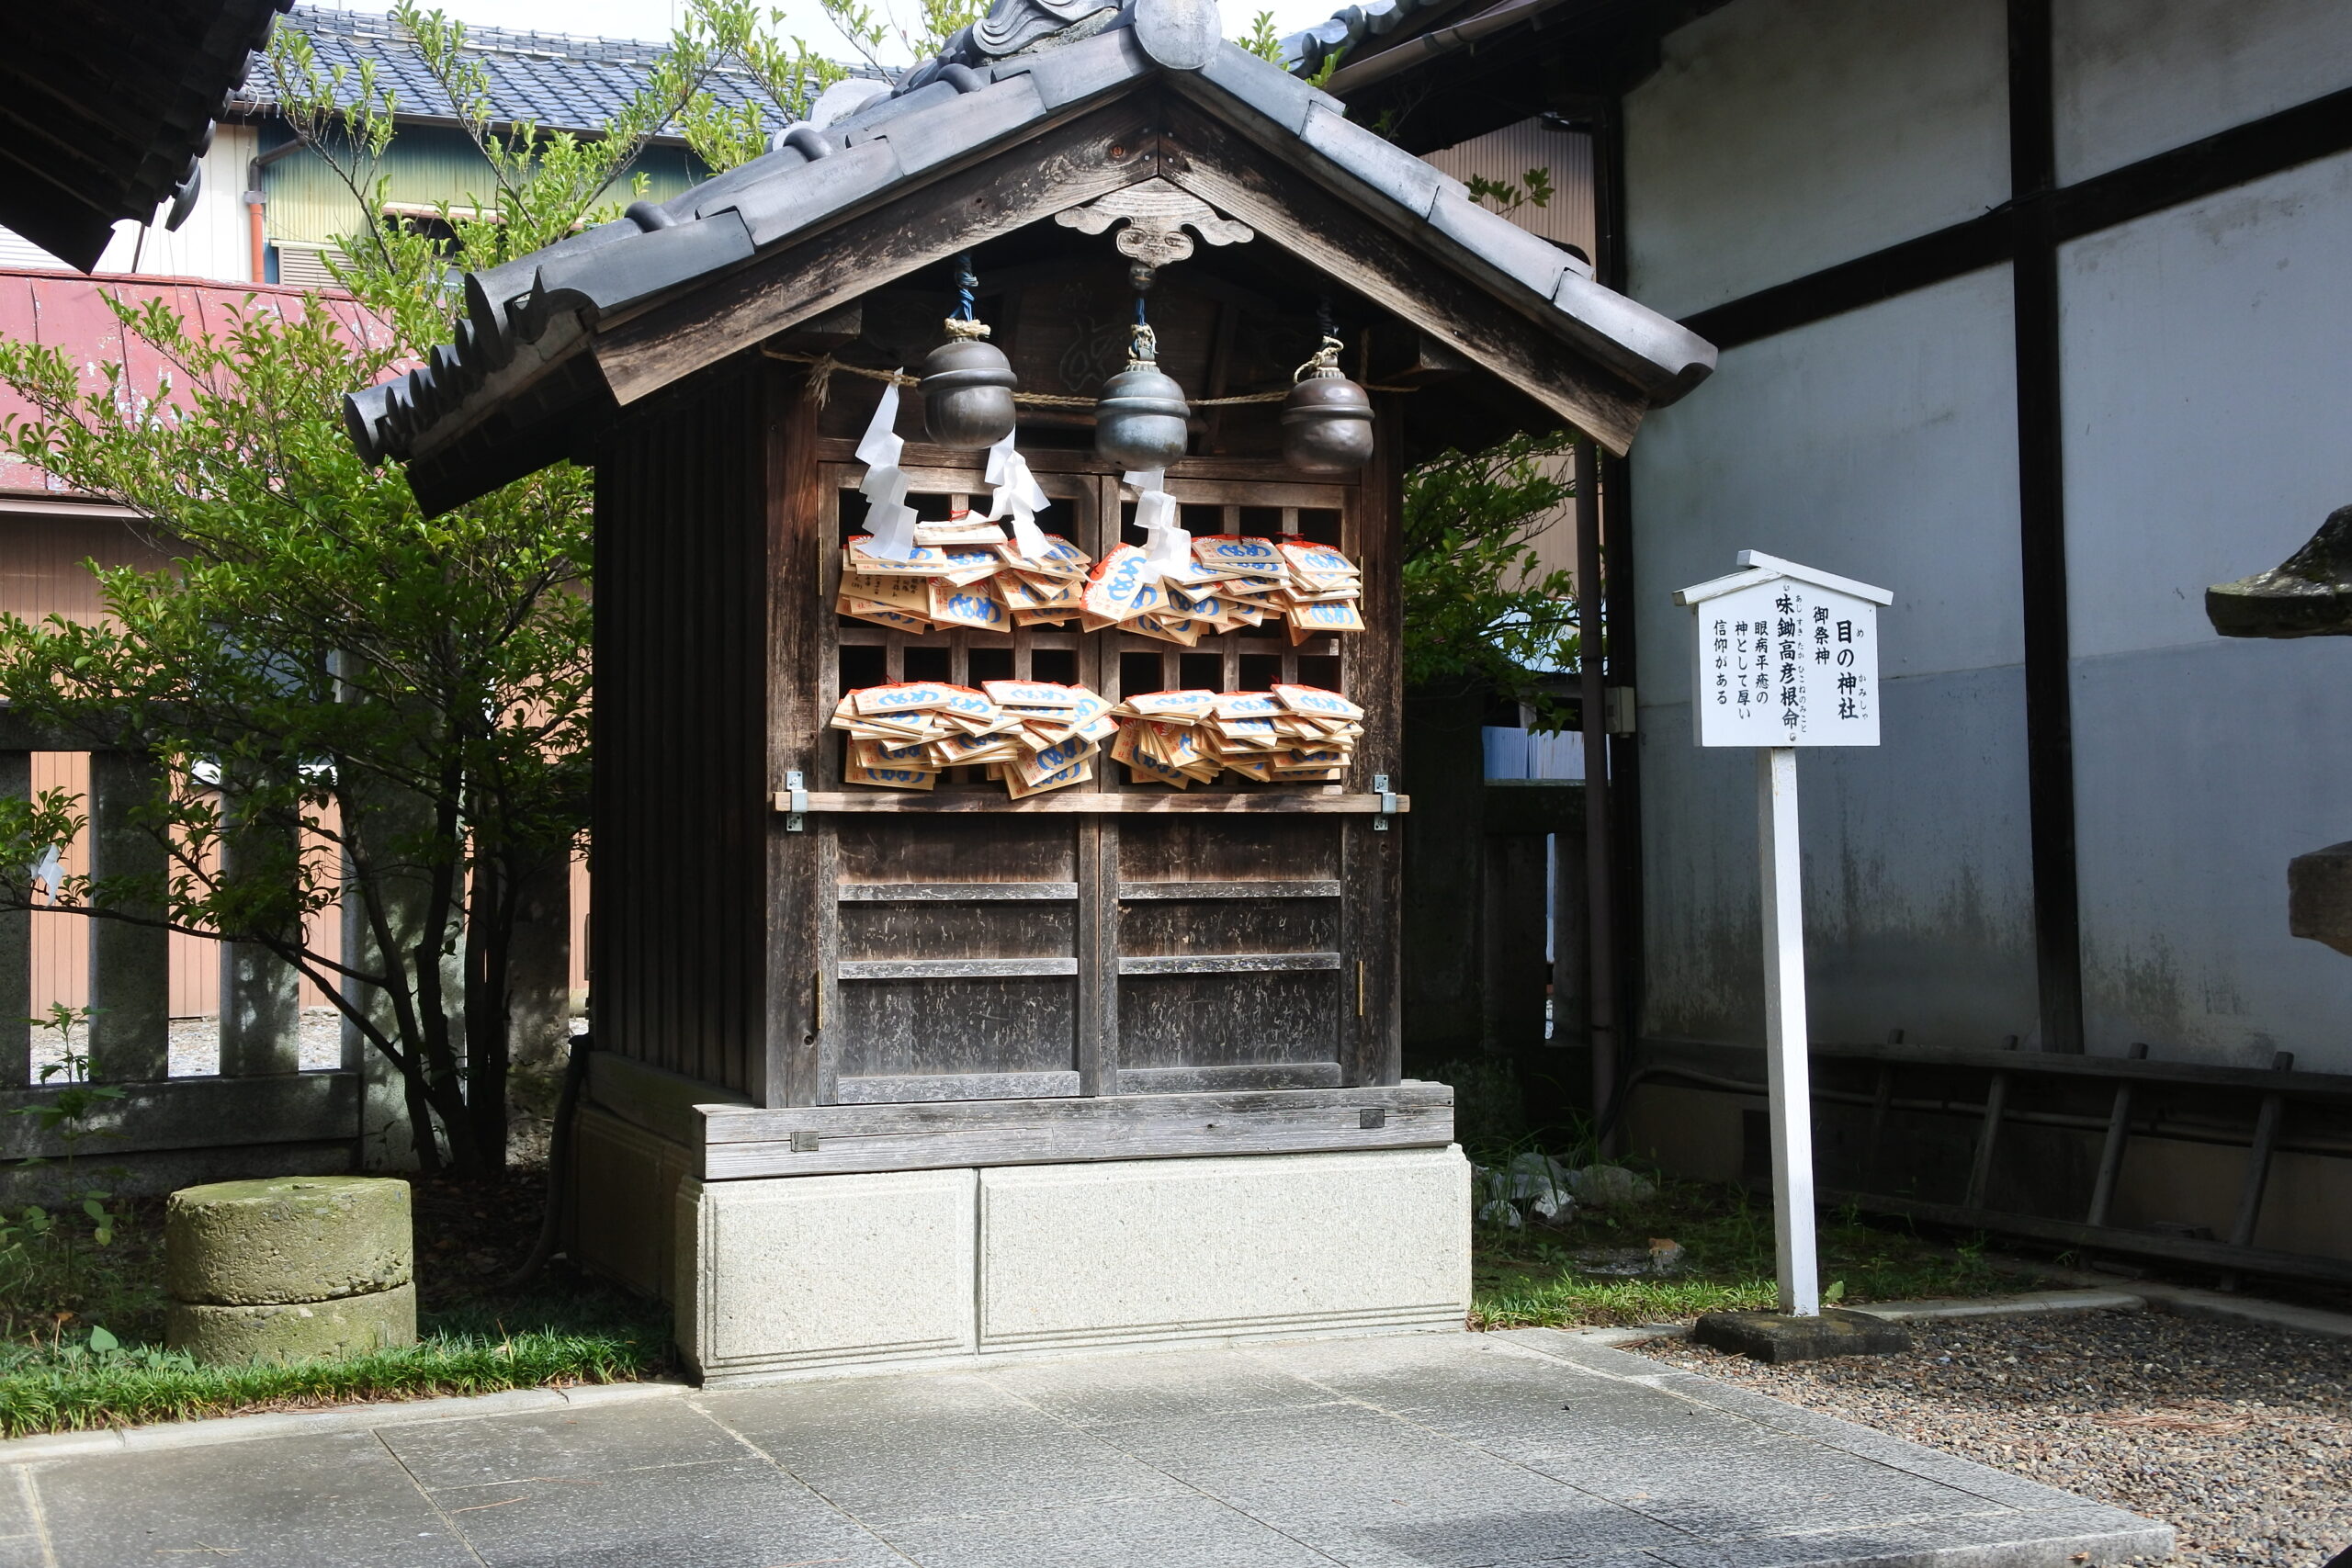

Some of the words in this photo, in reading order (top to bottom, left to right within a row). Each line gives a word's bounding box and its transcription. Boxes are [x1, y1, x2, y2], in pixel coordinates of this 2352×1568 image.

[1713, 618, 1728, 705] 信仰がある
[1734, 620, 1751, 720] 神として厚い
[1754, 620, 1770, 705] 眼病平癒の
[1774, 592, 1801, 730] 味鋤高彦根命
[1812, 605, 1831, 666] 御祭神
[1837, 619, 1860, 721] 目の神社
